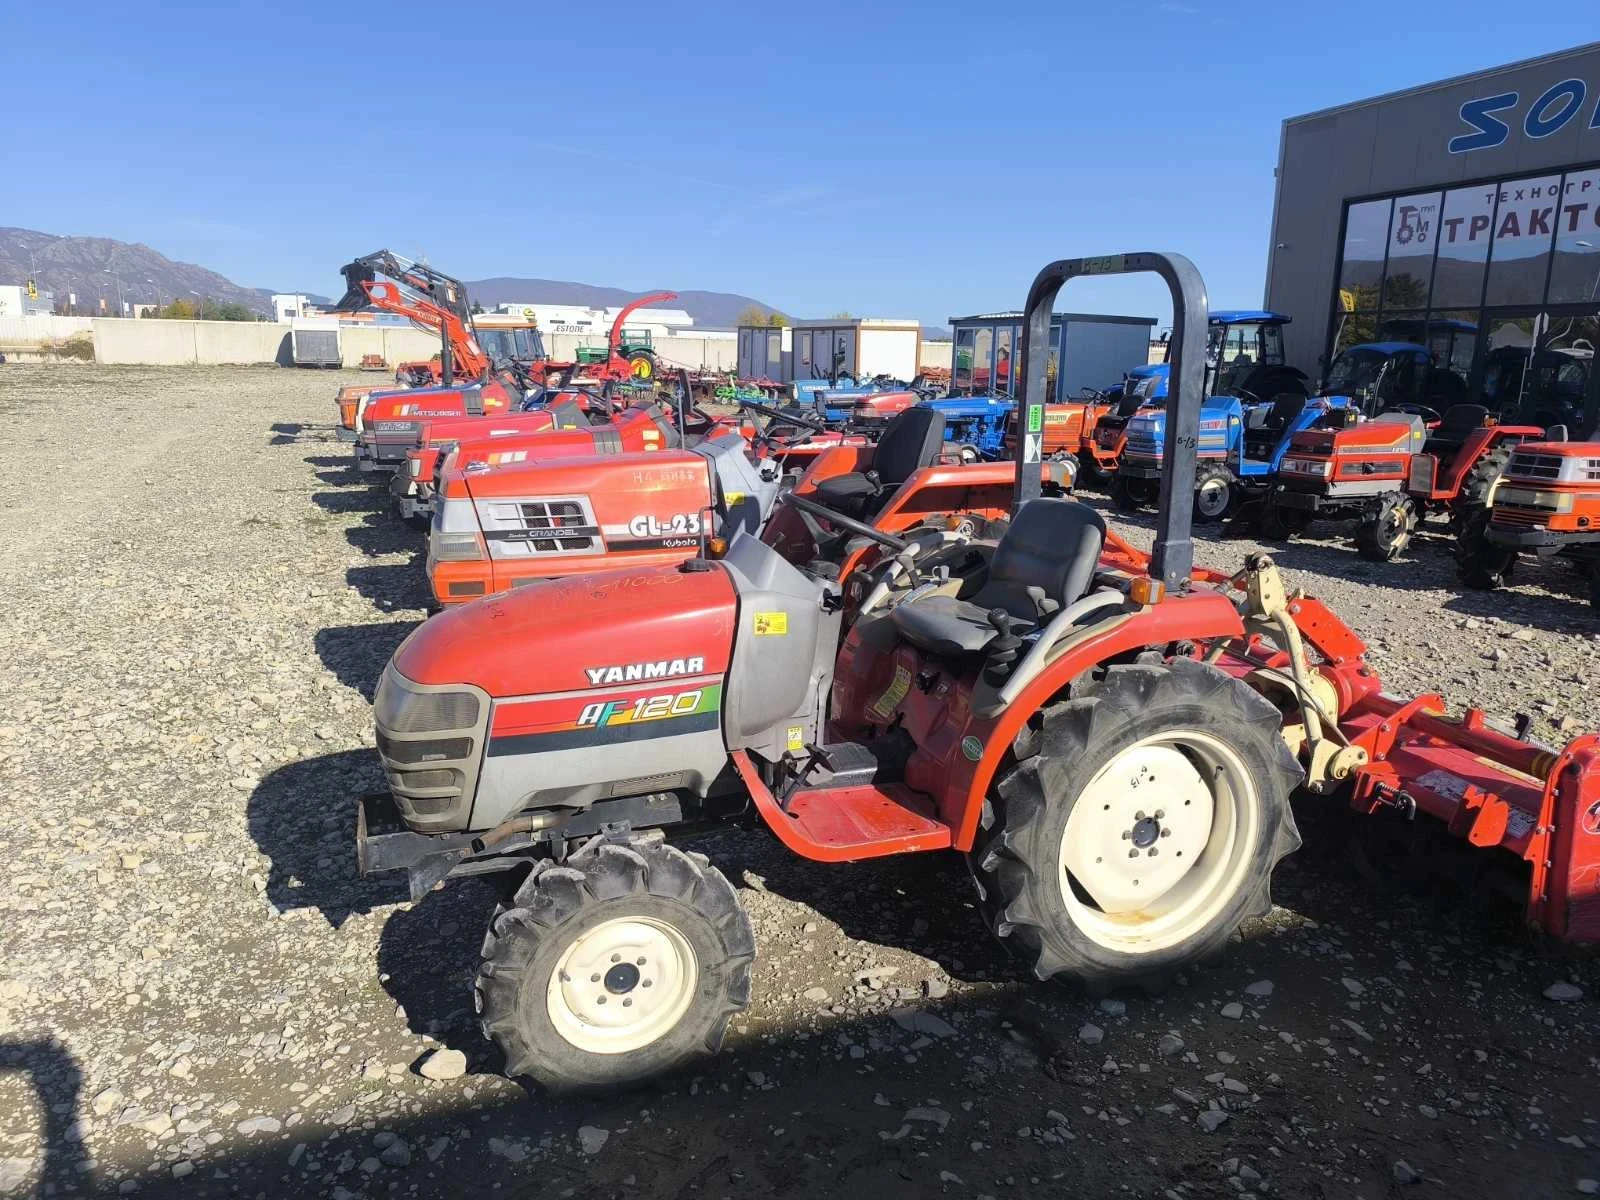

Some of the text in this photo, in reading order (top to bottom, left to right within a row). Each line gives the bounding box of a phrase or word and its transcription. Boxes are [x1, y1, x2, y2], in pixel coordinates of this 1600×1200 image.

[1448, 78, 1600, 154] SO
[1485, 180, 1600, 204] ТЕХНОГР
[528, 529, 579, 538] GRANDEL
[629, 513, 701, 538] GL-23
[663, 537, 697, 548] Kubota
[585, 656, 705, 686] YANMAR
